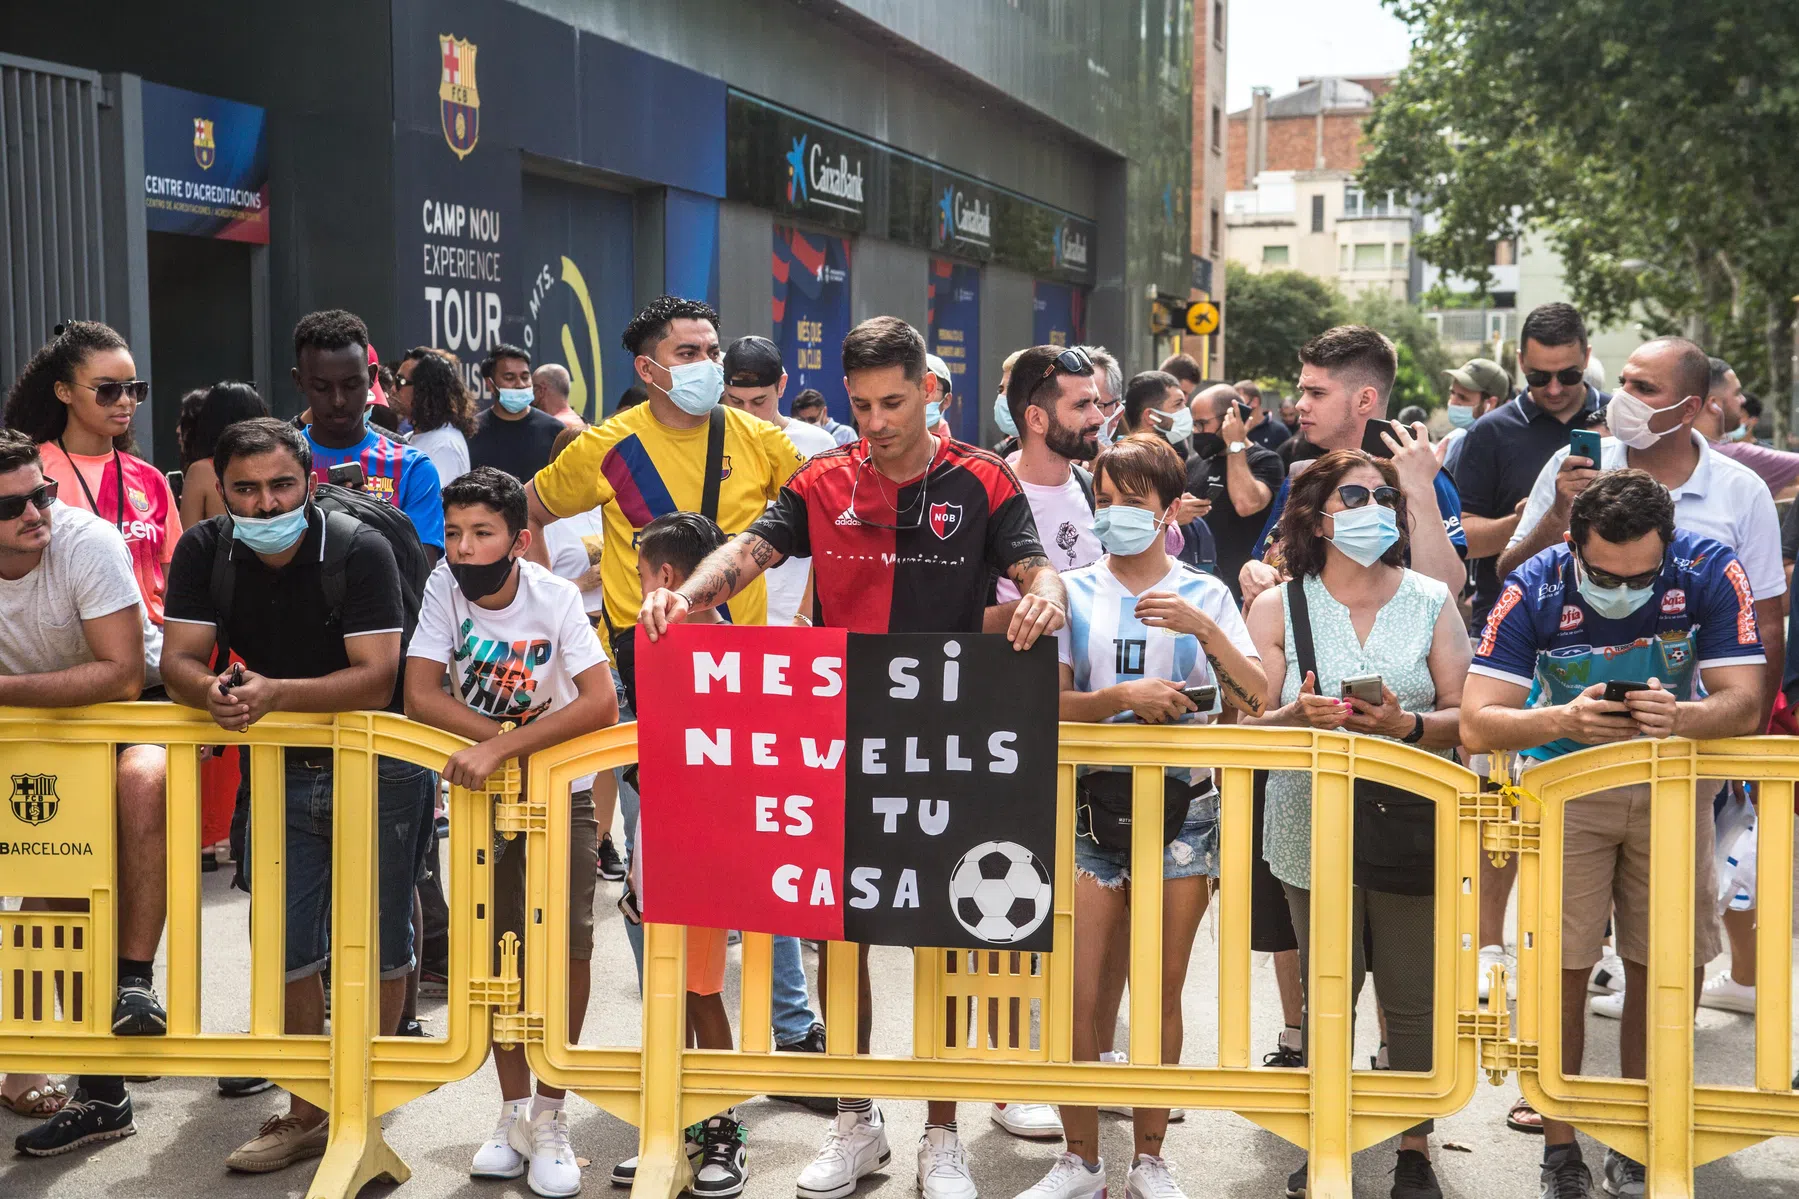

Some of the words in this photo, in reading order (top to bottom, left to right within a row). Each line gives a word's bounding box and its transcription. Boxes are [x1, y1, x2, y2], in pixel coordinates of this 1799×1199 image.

[451, 86, 468, 103] FCB
[145, 175, 183, 198] CENTRE
[185, 181, 261, 209] D'ACREDITACIONS
[810, 143, 864, 203] CaixaBank
[423, 199, 466, 237] CAMP
[470, 208, 500, 243] NOU
[955, 191, 991, 238] CaixaBank
[424, 244, 501, 282] EXPERIENCE
[425, 286, 502, 352] TOUR
[834, 518, 862, 527] adidas
[934, 512, 956, 523] NOB
[1113, 638, 1147, 675] 10
[685, 728, 1019, 775] NEWELLS
[755, 795, 814, 836] ES
[872, 797, 950, 836] TU
[0, 842, 93, 856] BARCELONA
[771, 863, 920, 909] CASA
